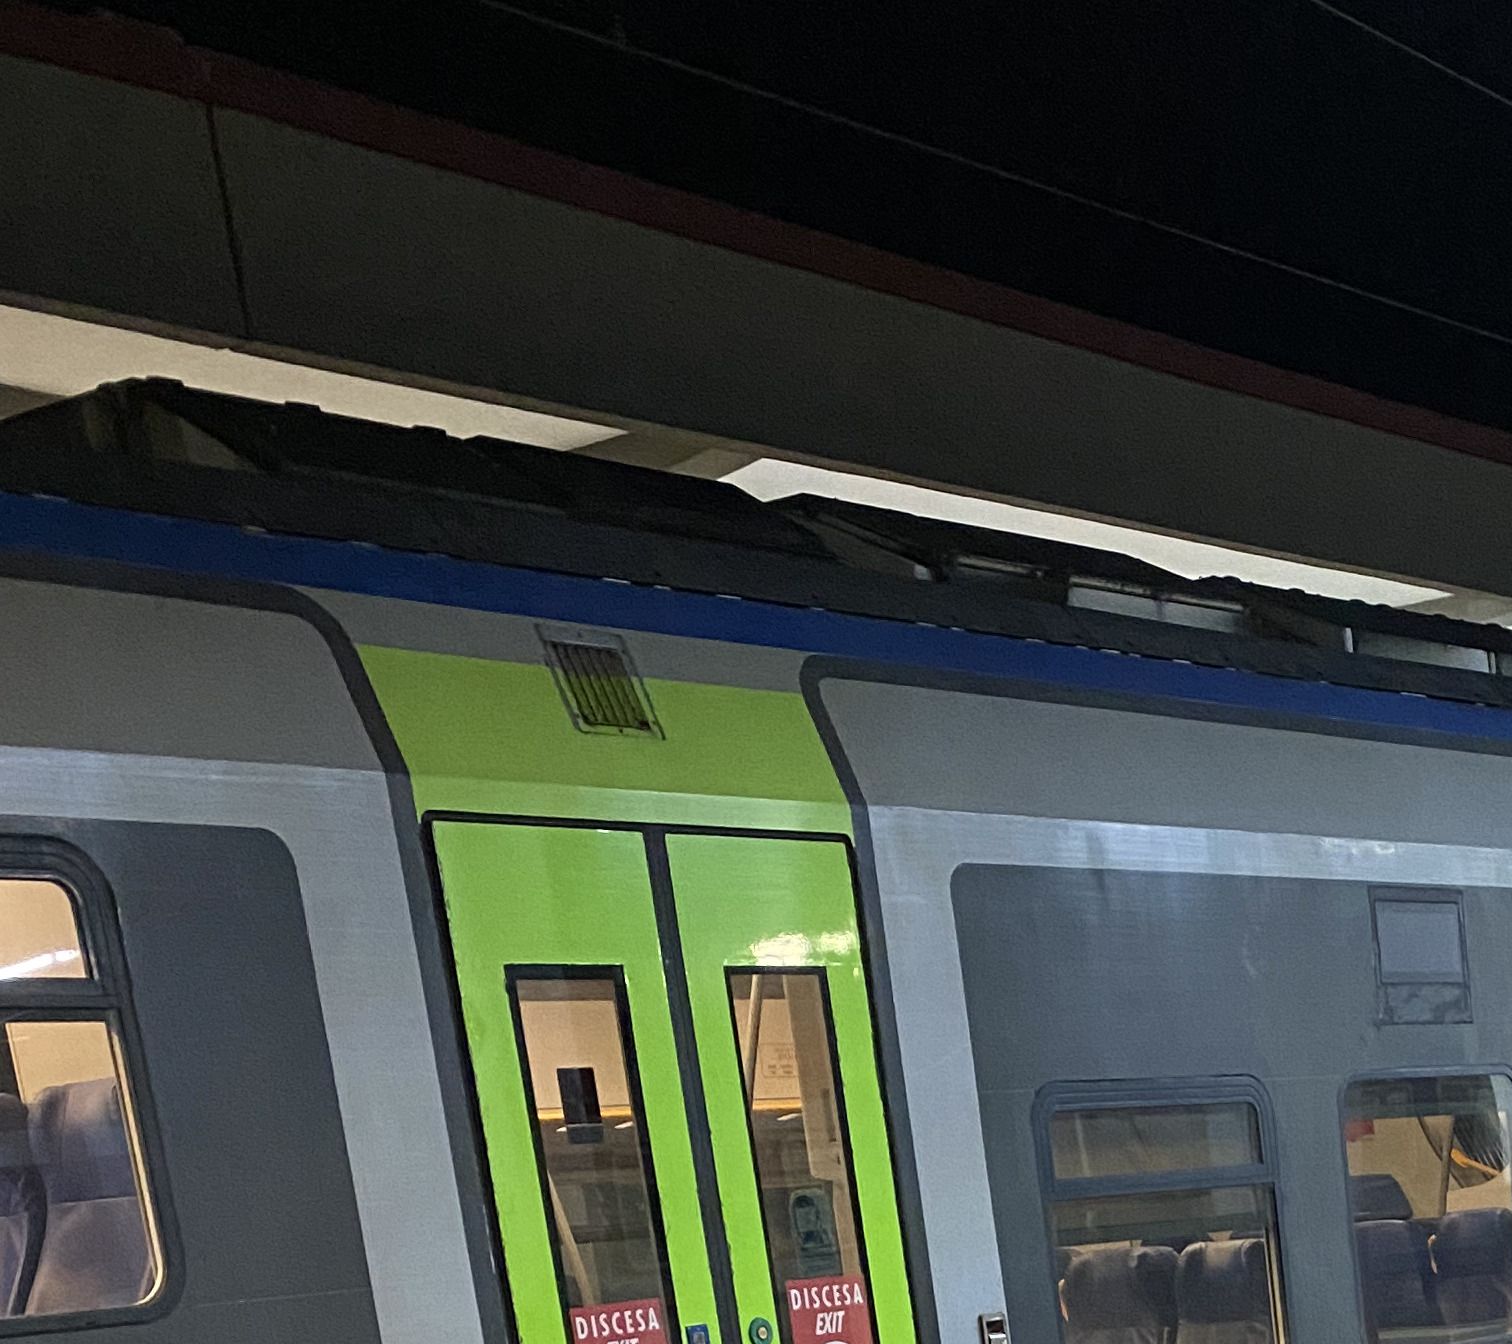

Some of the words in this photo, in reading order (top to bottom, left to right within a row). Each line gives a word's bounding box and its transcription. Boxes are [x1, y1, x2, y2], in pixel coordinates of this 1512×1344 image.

[790, 1282, 864, 1310] DISCESA
[575, 1306, 660, 1340] DISCESA
[815, 1310, 845, 1336] EXIT
